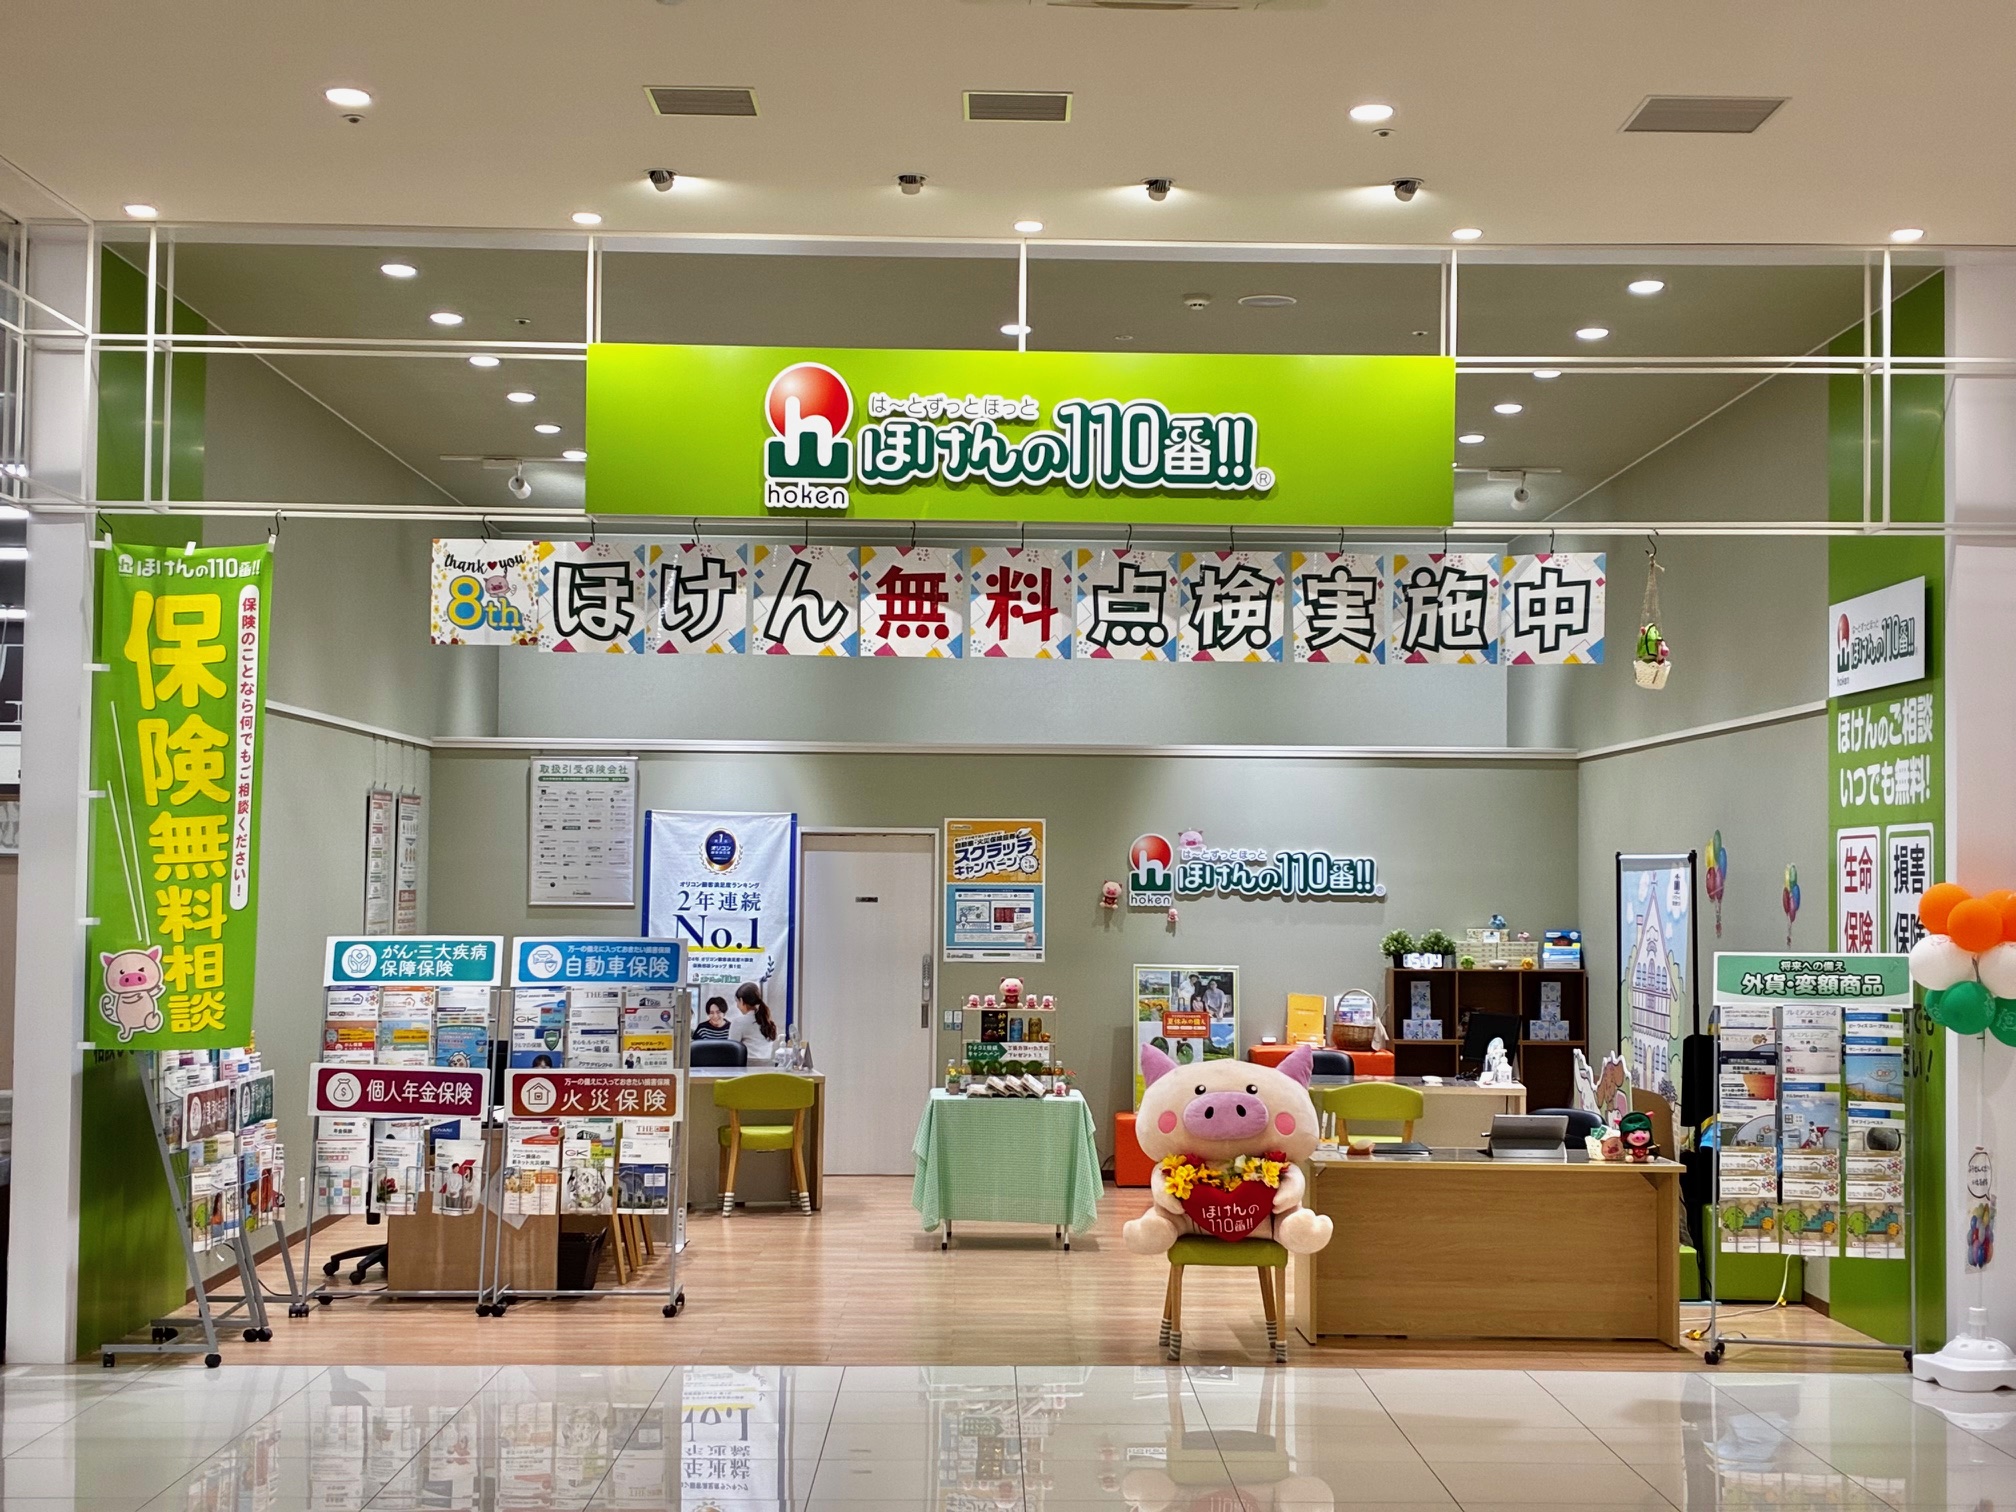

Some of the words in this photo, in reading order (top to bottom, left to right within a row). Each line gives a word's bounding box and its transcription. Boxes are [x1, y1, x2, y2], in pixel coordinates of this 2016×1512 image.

[861, 401, 1255, 488] ほけんの110番!!
[767, 484, 847, 507] hoken
[444, 554, 488, 574] thank
[498, 554, 527, 578] you
[447, 575, 525, 631] 8th
[1837, 693, 1934, 754] ほけんのご相談
[539, 764, 629, 775] 取扱引受保険会社
[124, 590, 232, 1033] 保険無料相談
[954, 836, 1033, 864] スクラッチ
[954, 857, 1018, 875] キャンペーン
[1177, 852, 1376, 894] ほけんの110番!!
[1843, 845, 1874, 895] 生命
[1893, 843, 1926, 895] 損害
[676, 889, 762, 912] 2年連続
[1130, 894, 1170, 906] hoken
[672, 914, 761, 949] No.1
[380, 943, 488, 960] がん・三大疾病
[379, 960, 454, 977] 保障保険
[565, 954, 670, 979] 自動車保険
[1780, 960, 1845, 972] 将来への備え
[1741, 973, 1884, 996] 外貨・変額商品
[515, 1016, 539, 1024] GK
[366, 1079, 474, 1106] 個人年金保険
[564, 1078, 671, 1086] 万一の備えに入っておきたい損害保険
[560, 1088, 668, 1113] 火災保険
[564, 1149, 589, 1158] GK
[1201, 1203, 1260, 1218] ほけんの
[1208, 1217, 1254, 1233] 110番!!
